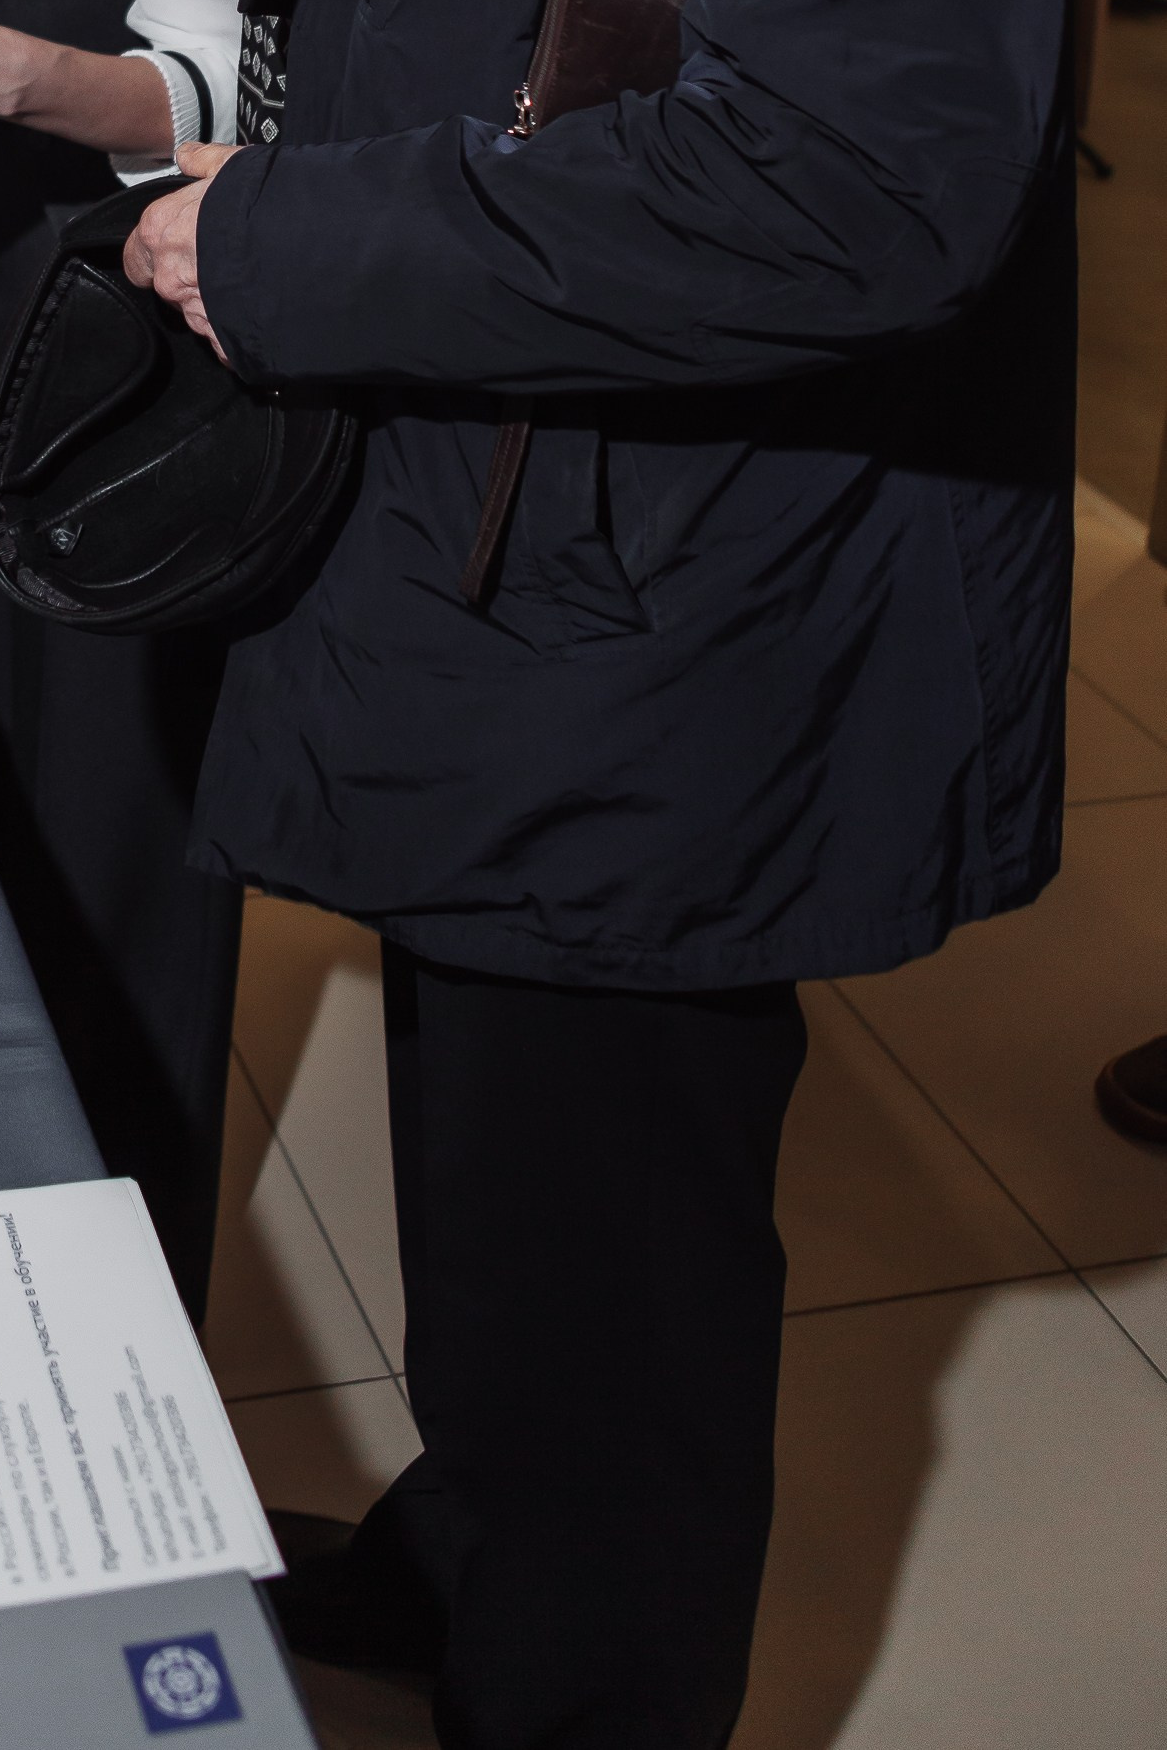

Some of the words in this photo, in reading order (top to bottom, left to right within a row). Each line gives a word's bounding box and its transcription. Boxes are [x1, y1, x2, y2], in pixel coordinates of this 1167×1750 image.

[0, 1214, 32, 1284] обучении!
[28, 1300, 59, 1357] участие
[48, 1361, 76, 1425] принять
[67, 1430, 84, 1455] вас
